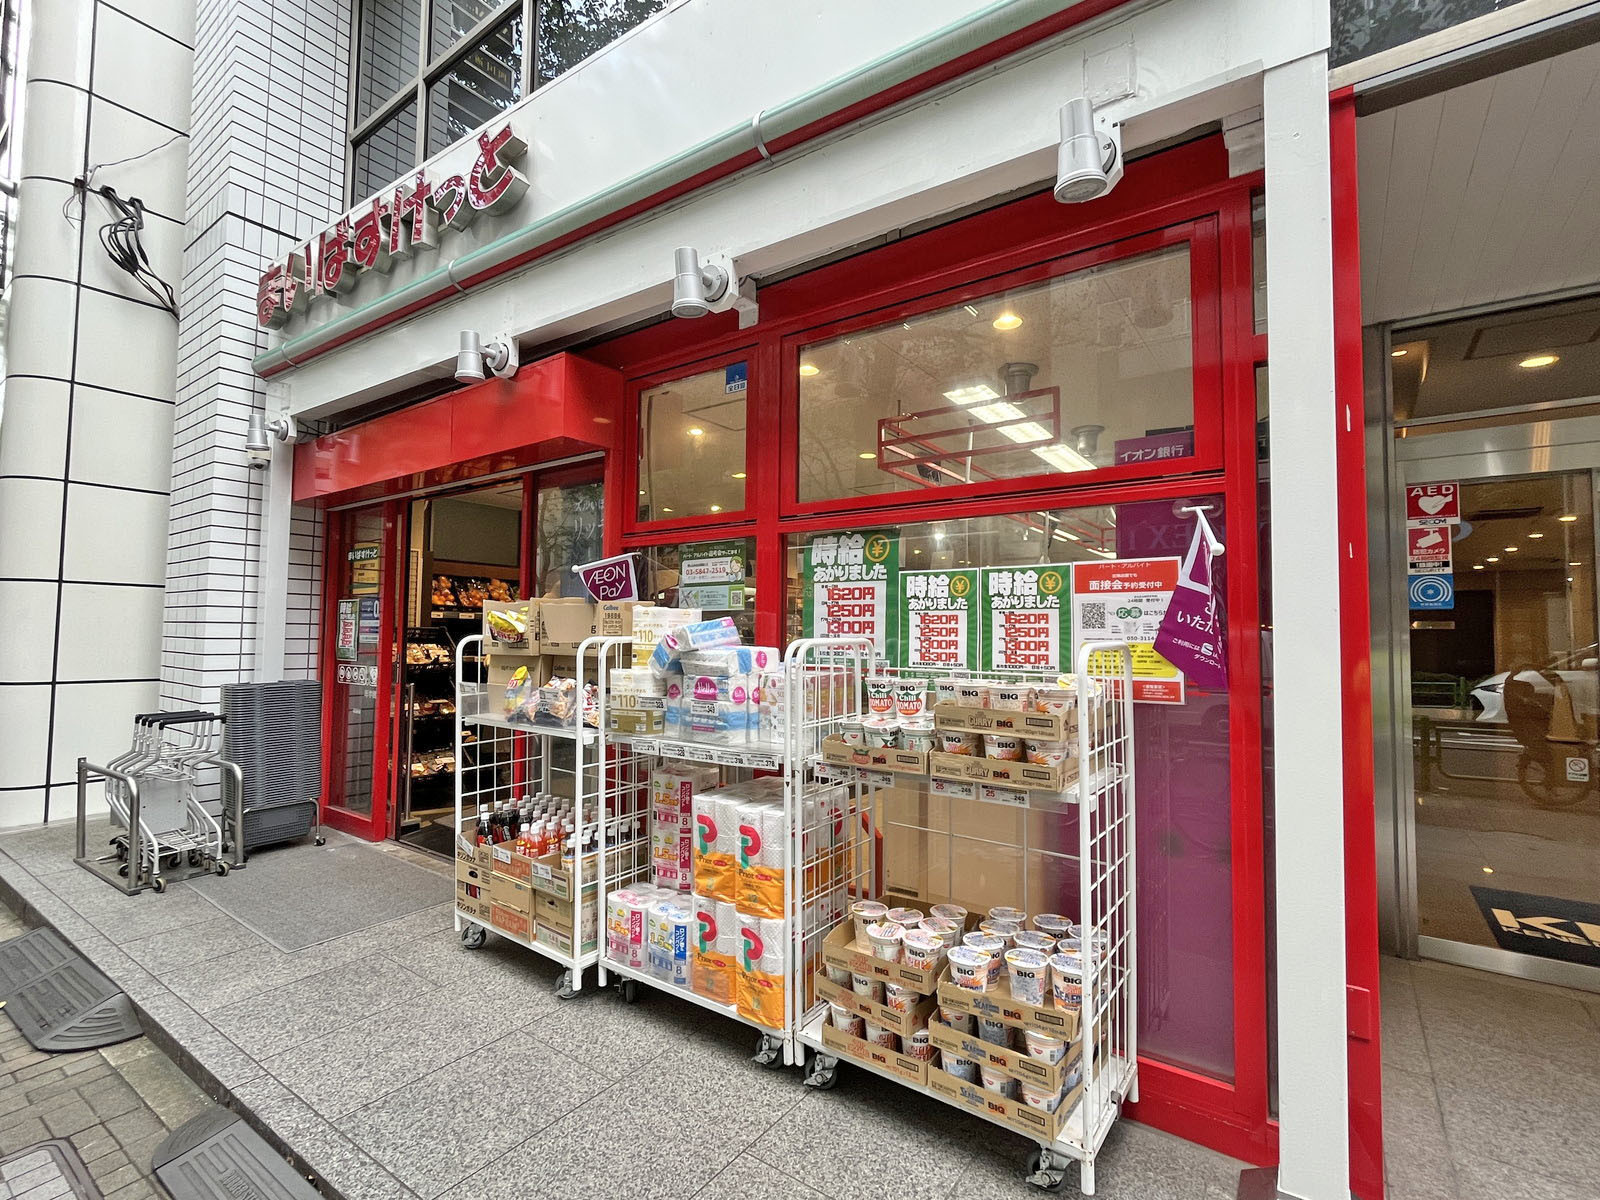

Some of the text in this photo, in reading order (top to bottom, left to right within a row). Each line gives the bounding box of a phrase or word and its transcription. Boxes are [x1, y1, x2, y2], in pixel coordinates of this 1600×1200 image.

[256, 121, 517, 328] まいばすけっと
[1120, 445, 1184, 461] イオン銀行
[1410, 485, 1454, 497] AED
[811, 533, 865, 566] 時給
[813, 563, 887, 582] あがりました
[907, 575, 950, 598] 時給
[989, 570, 1038, 596] 時給
[1088, 580, 1163, 591] 面接会予約受付中
[827, 587, 875, 600] 1620円
[908, 597, 969, 610] あがりました
[991, 595, 1060, 609] あがりました
[827, 604, 875, 617] 1250円
[920, 614, 959, 625] 1620円
[1004, 614, 1049, 625] 1620円
[827, 621, 875, 634] 1300円
[920, 627, 959, 637] 1250円
[1004, 627, 1049, 638] 1250円
[920, 640, 959, 650] 1300円
[1004, 640, 1049, 651] 1300円
[920, 652, 959, 662] 1630円
[1004, 654, 1049, 665] 1630円
[996, 720, 1013, 728] BIG
[993, 770, 1010, 779] BIG
[909, 949, 925, 958] BIG
[874, 966, 889, 976] BIG
[957, 967, 974, 976] BIG
[1017, 970, 1035, 978] BIG
[855, 977, 868, 986] BIG
[859, 1003, 872, 1014] BIG
[1003, 1009, 1021, 1020] BIG
[985, 1019, 1003, 1029] BIG
[872, 1052, 886, 1063] BIG
[990, 1054, 1007, 1067] BIG
[988, 1101, 1005, 1115] BIG
